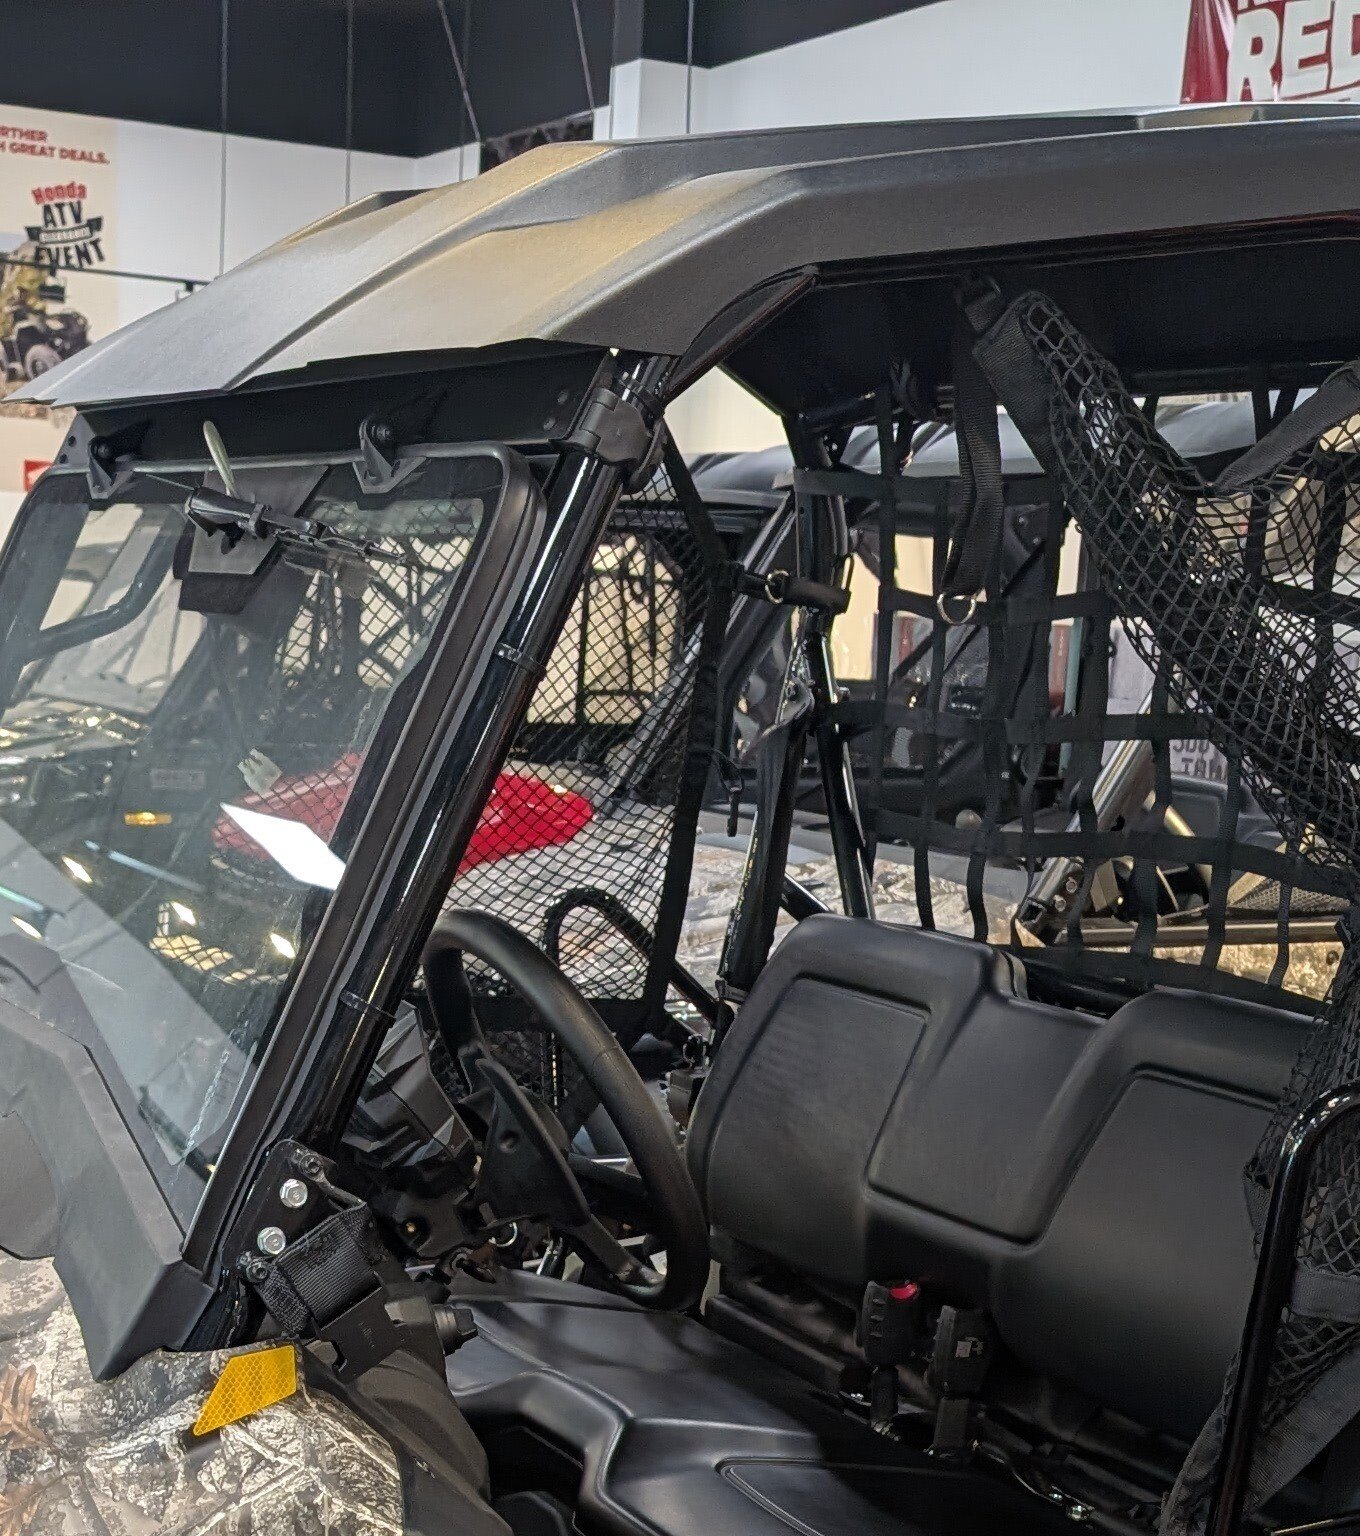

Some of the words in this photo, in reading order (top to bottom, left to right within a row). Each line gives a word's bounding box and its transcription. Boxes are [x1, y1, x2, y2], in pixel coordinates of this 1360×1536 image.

[9, 142, 55, 158] GREAT
[43, 200, 82, 228] ATV
[34, 238, 105, 269] EVENT
